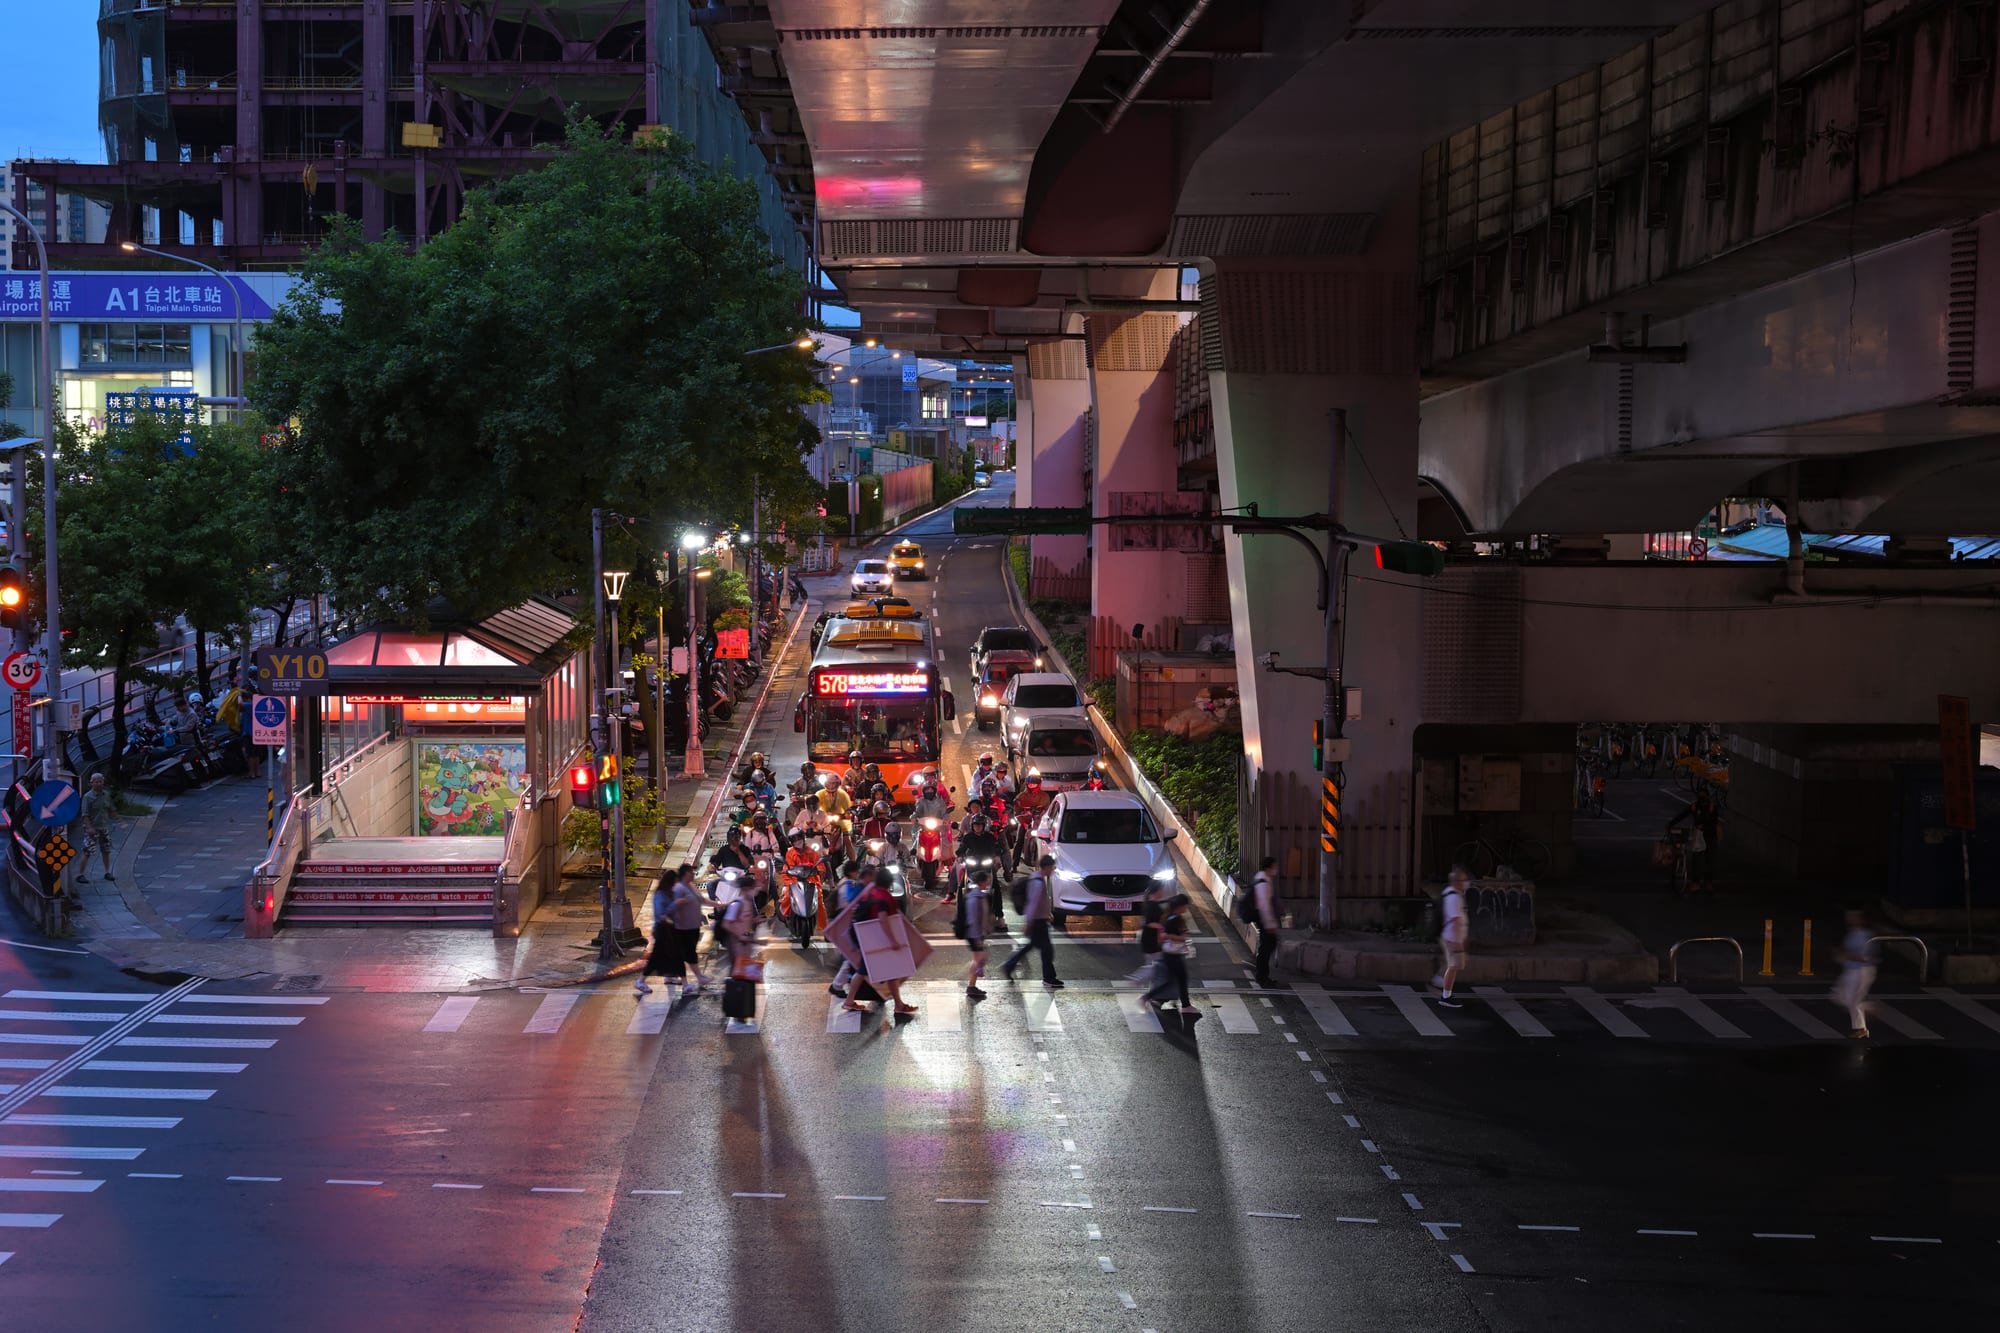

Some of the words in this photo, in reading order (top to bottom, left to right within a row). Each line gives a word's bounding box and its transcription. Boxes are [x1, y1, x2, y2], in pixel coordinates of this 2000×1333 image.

[105, 287, 139, 311] A1
[144, 286, 221, 304] 台北車站
[0, 301, 38, 314] irport
[145, 304, 169, 314] Taipei
[171, 304, 191, 312] Main
[192, 304, 222, 313] Station
[903, 371, 916, 379] 300
[11, 663, 33, 677] 30
[269, 655, 325, 678] Y10
[820, 674, 848, 693] 578
